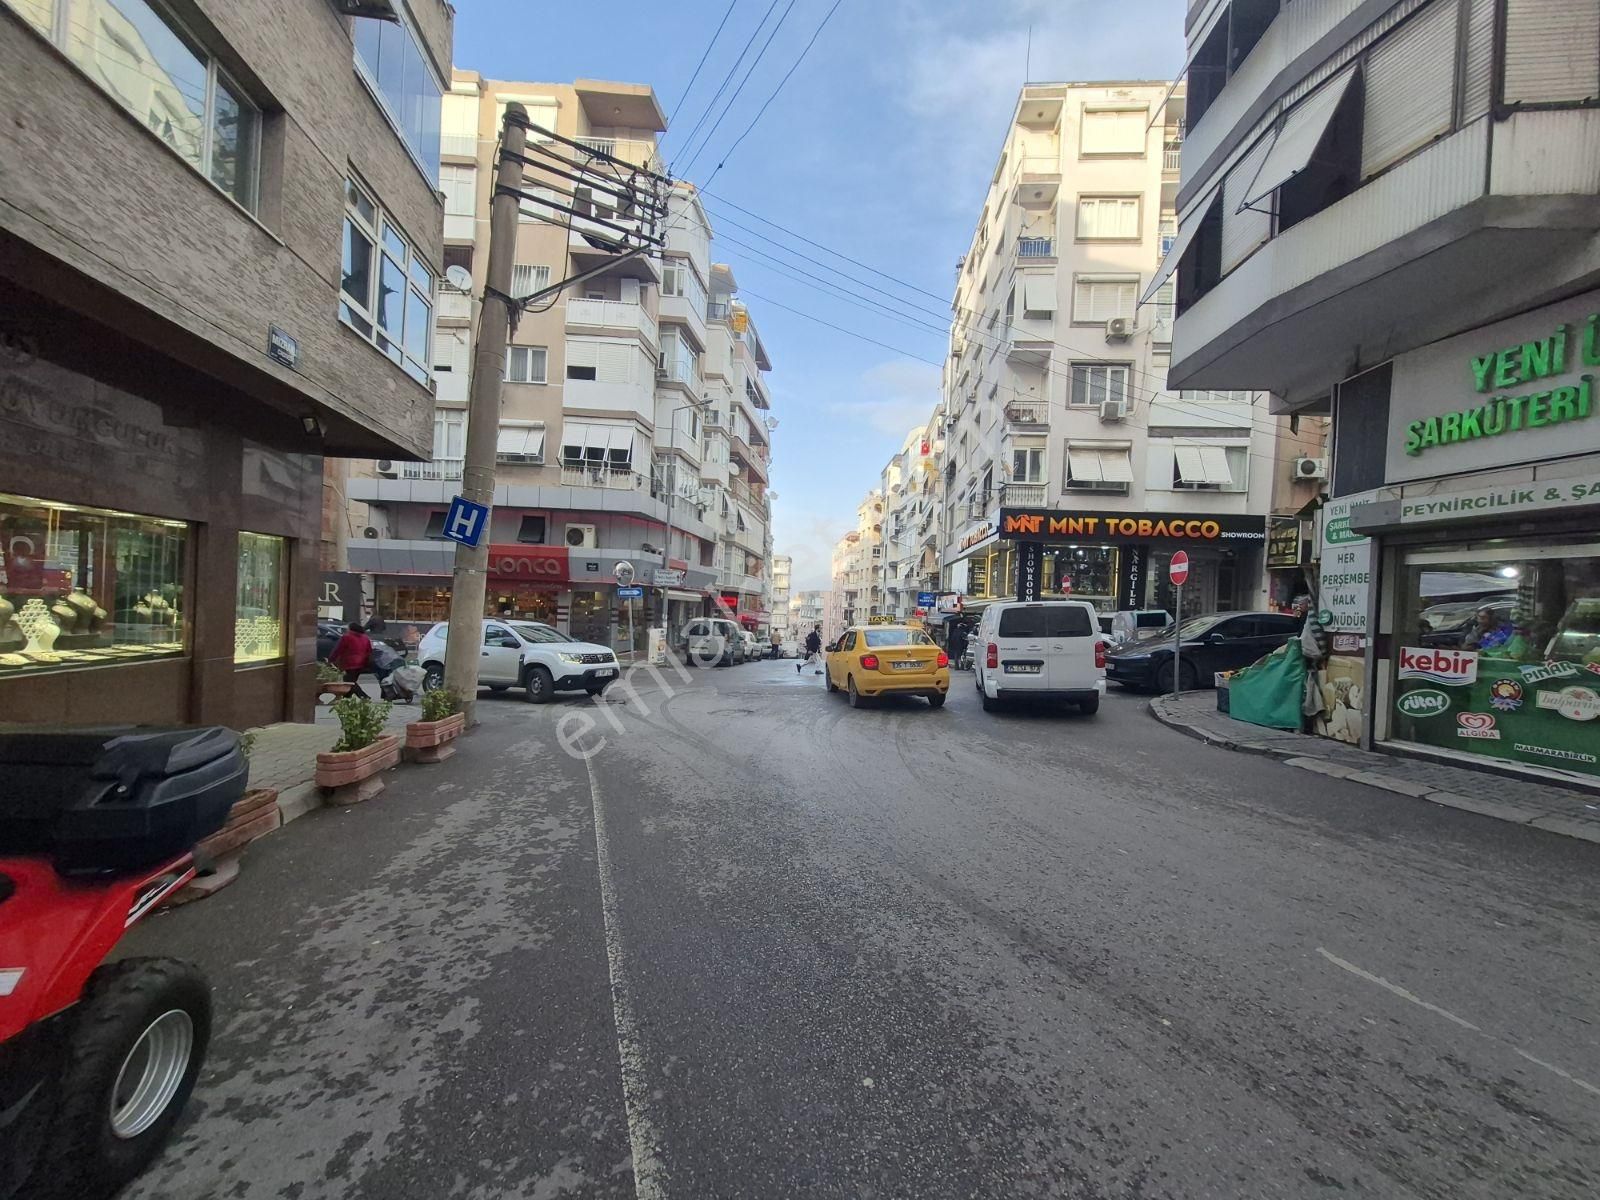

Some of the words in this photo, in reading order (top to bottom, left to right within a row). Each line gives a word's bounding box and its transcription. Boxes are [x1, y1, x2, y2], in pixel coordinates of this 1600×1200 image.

[1470, 324, 1566, 393] YENİ
[1405, 374, 1594, 457] ŞARKÜTERİ
[1403, 489, 1534, 516] PEYNİRCİLİK
[451, 504, 479, 537] H
[1050, 517, 1099, 535] MNT
[1106, 518, 1221, 538] TOBACCO
[1221, 530, 1265, 539] SHOWROOM
[1337, 552, 1355, 564] HER
[1025, 546, 1035, 602] SHOWROOM
[1322, 572, 1370, 587] PERŞEMBE
[1332, 594, 1356, 606] HALK
[1400, 647, 1474, 674] kebir
[1459, 729, 1496, 738] ALGIDA
